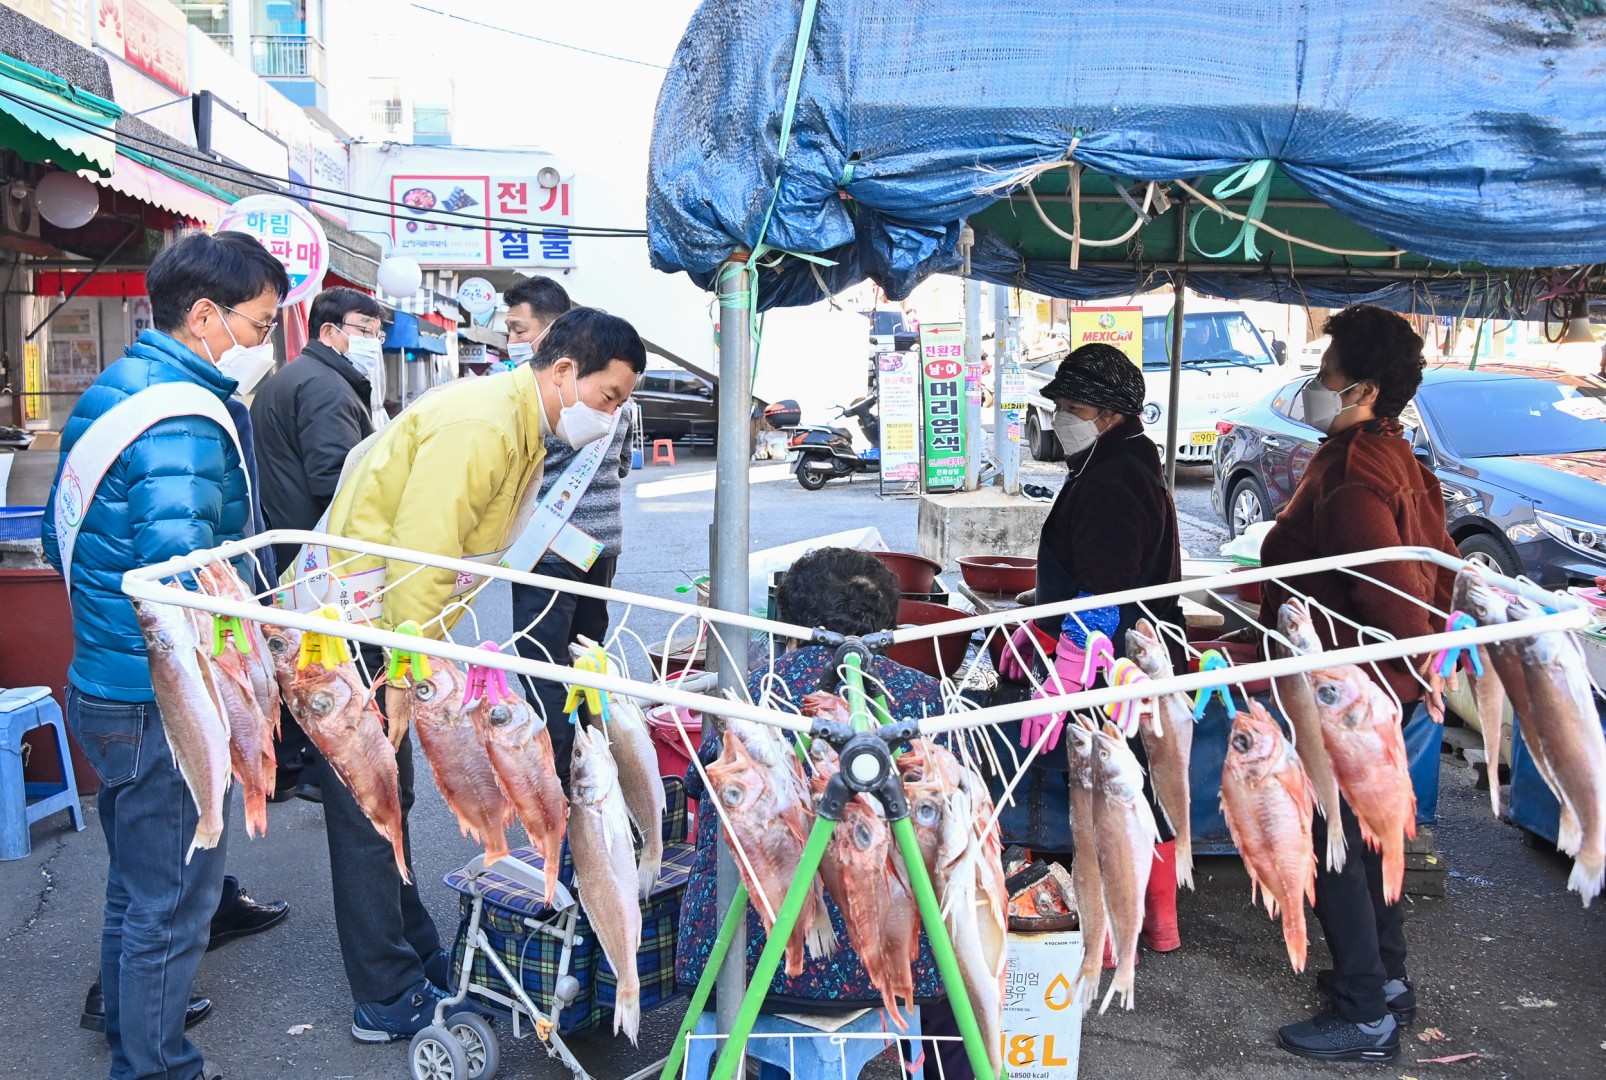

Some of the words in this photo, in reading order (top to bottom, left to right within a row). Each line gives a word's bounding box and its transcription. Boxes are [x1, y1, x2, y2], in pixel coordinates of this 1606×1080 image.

[497, 182, 569, 216] 전기
[247, 212, 290, 236] 하림
[259, 239, 320, 270] 판매
[499, 227, 572, 260] 철물
[1082, 331, 1133, 342] MEXICAN
[929, 380, 961, 452] 머리염색
[1006, 972, 1040, 986] 리미엄
[1032, 1071, 1050, 1080] kcal)
